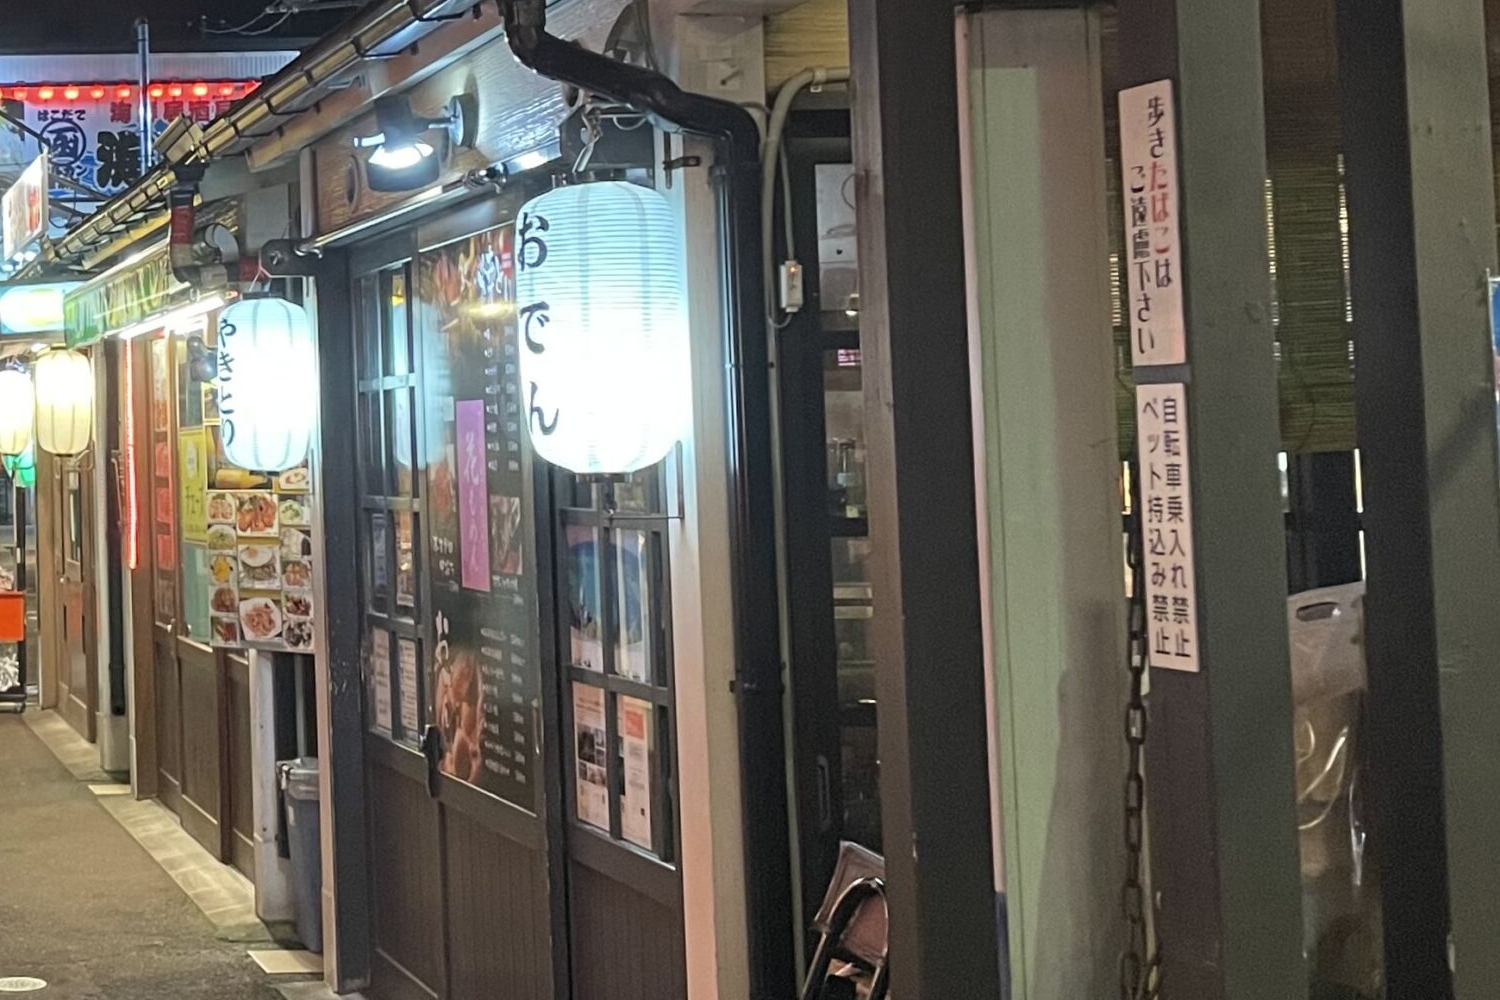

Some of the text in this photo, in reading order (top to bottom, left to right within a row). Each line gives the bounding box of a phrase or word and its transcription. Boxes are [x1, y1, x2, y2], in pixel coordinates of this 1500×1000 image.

[38, 110, 86, 121] はこだて
[518, 211, 560, 436] おでん
[1130, 165, 1155, 354] ご遠慮下さい
[218, 318, 237, 447] やきとり
[1143, 398, 1171, 655] ペット持込み禁止
[1163, 397, 1191, 657] 自転車乗入れ禁止
